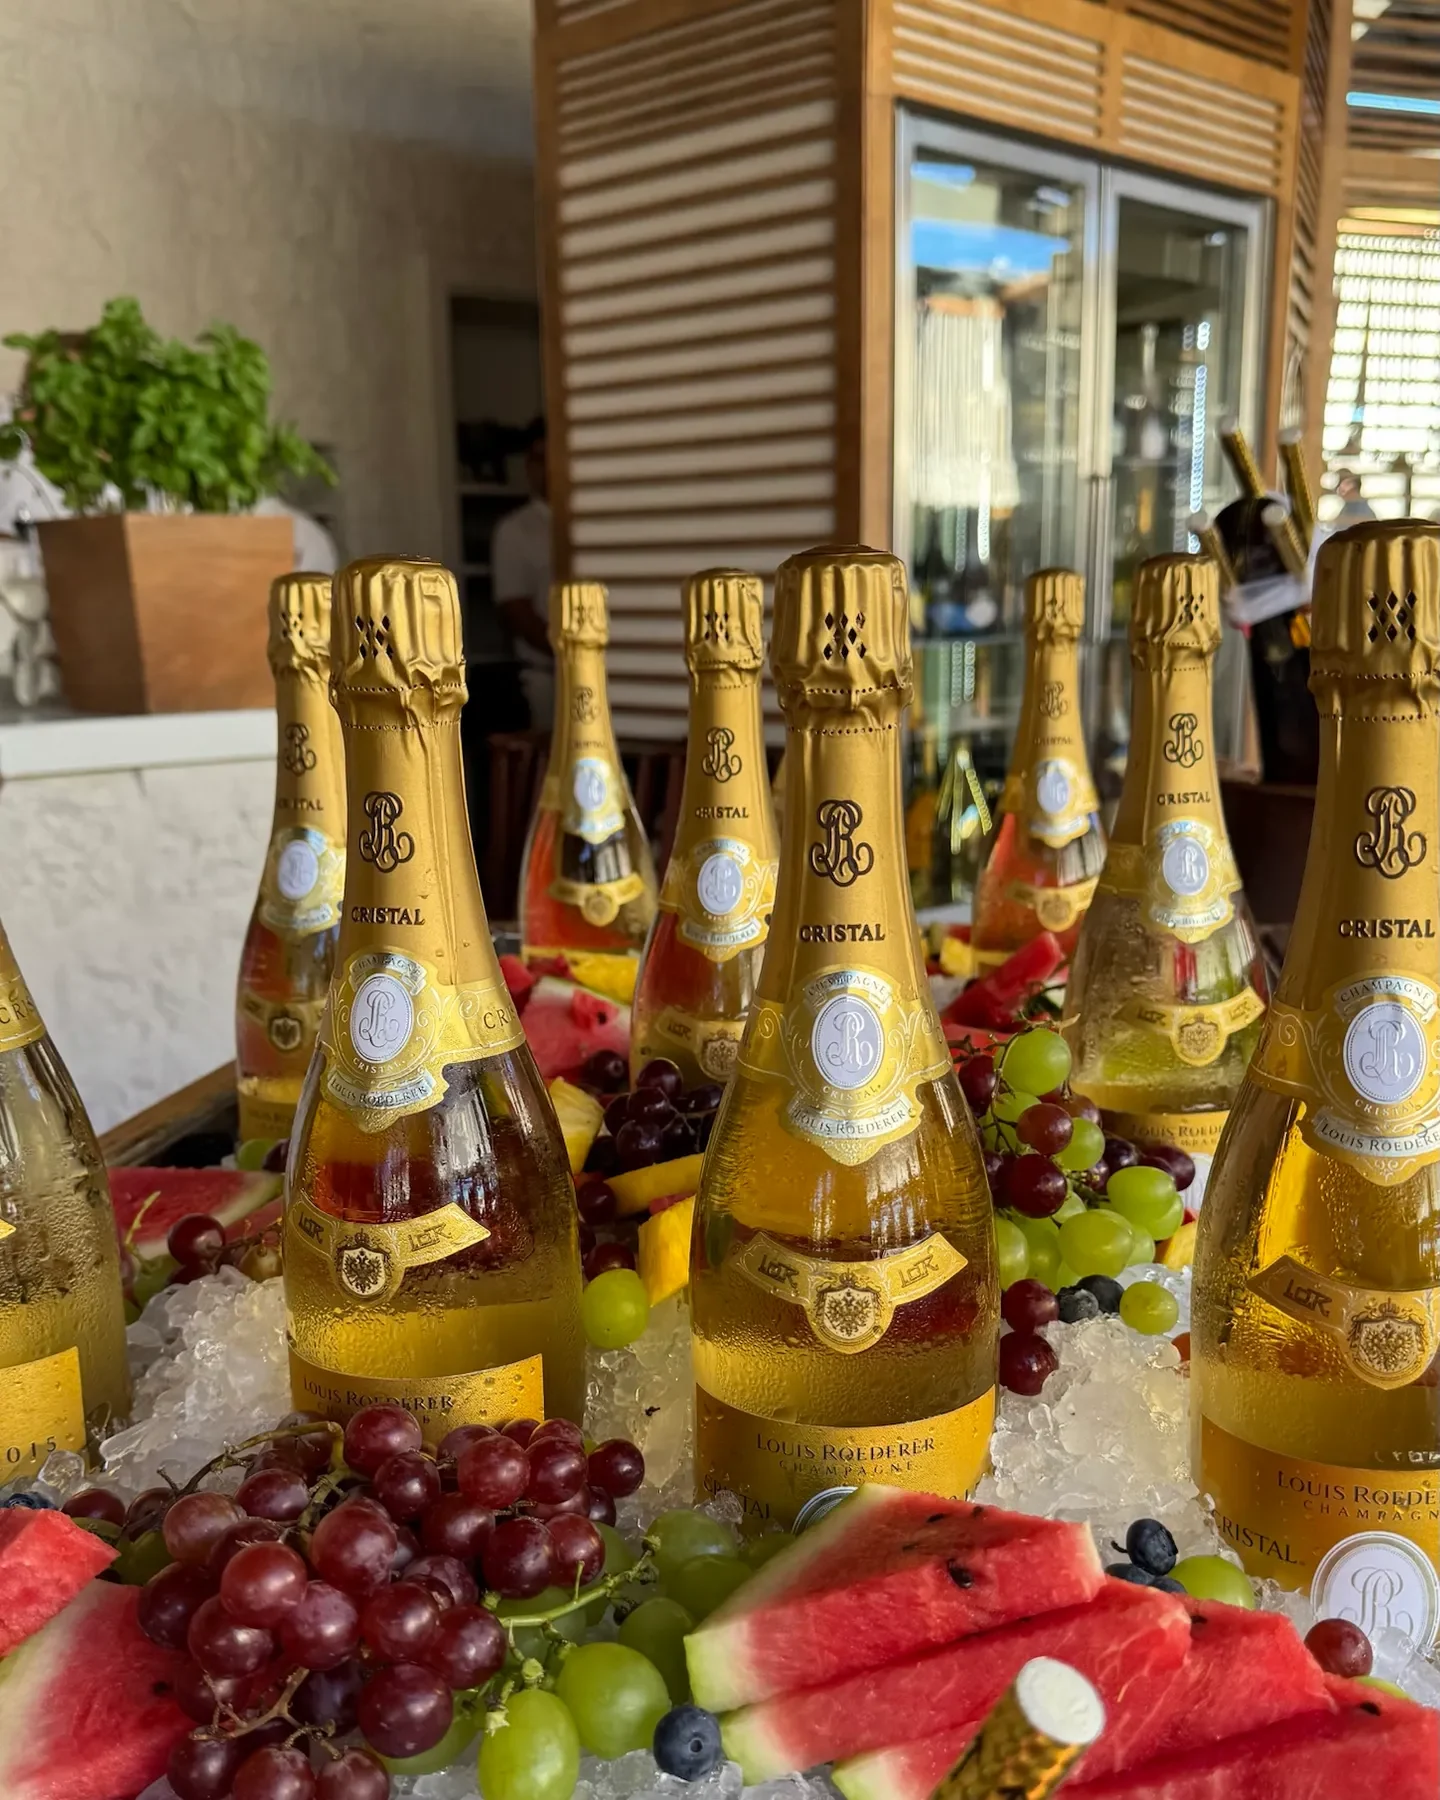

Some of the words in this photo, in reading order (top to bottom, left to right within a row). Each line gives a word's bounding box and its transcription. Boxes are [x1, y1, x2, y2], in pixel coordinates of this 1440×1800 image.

[1157, 791, 1210, 806] CRISTAL
[696, 806, 749, 819] CRISTAL
[351, 906, 426, 926] CRISTAL
[800, 924, 886, 943] CRISTAL
[1338, 919, 1435, 939] CRISTAL
[1340, 979, 1431, 1003] CHAMPAGNE
[331, 1078, 357, 1100] LOUIS
[793, 1106, 832, 1134] LOUIS
[836, 1109, 907, 1136] ROEDERER
[1320, 1122, 1364, 1150] LOUIS
[303, 1377, 342, 1404] LOUIS
[757, 1433, 816, 1460] LOUIS
[822, 1436, 936, 1462] ROEDERER
[779, 1459, 914, 1477] CHAMPAGNE
[1277, 1470, 1346, 1500] LOUIS
